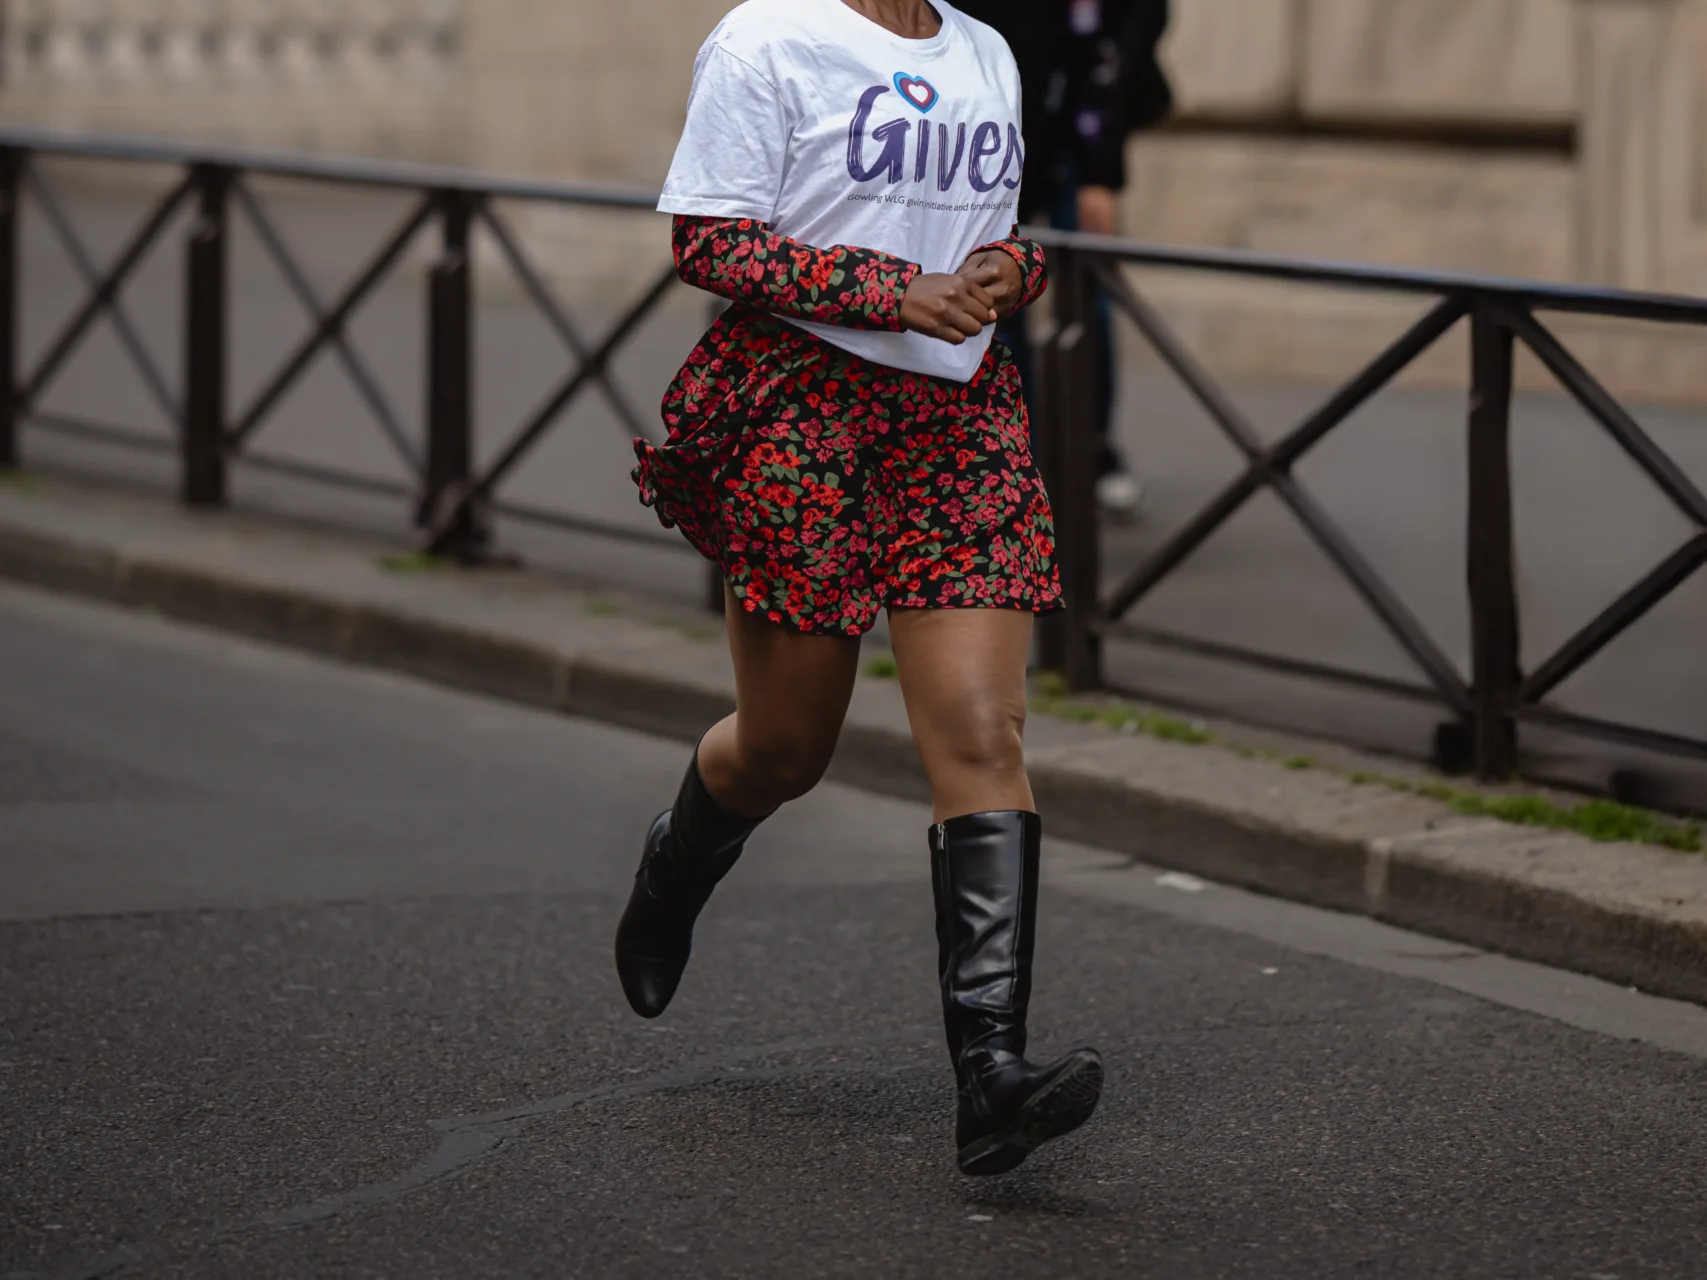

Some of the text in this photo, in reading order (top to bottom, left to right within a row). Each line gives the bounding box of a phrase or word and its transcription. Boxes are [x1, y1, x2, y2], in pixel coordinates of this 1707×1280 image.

[846, 85, 1025, 193] Gives
[847, 193, 883, 204] Gowling
[884, 194, 905, 204] WLG
[906, 197, 924, 208] givin
[953, 202, 969, 211] and
